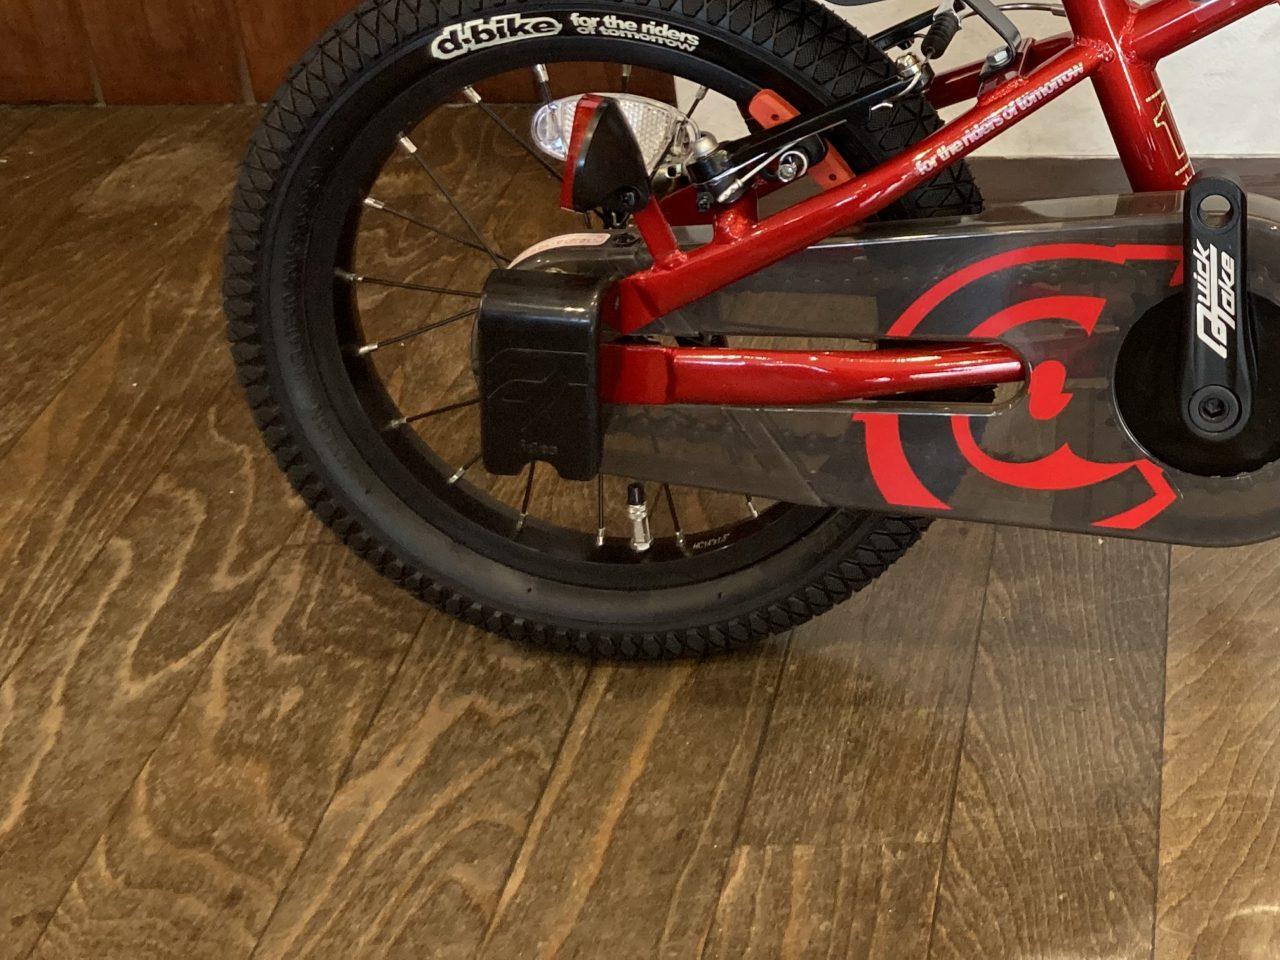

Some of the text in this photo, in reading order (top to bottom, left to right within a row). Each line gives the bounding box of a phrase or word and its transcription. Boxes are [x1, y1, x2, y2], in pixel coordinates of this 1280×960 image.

[570, 12, 700, 46] for the riders
[576, 26, 697, 52] of tomorrow
[914, 62, 1084, 175] for the riders of tomorrow
[1193, 238, 1228, 359] Quick
